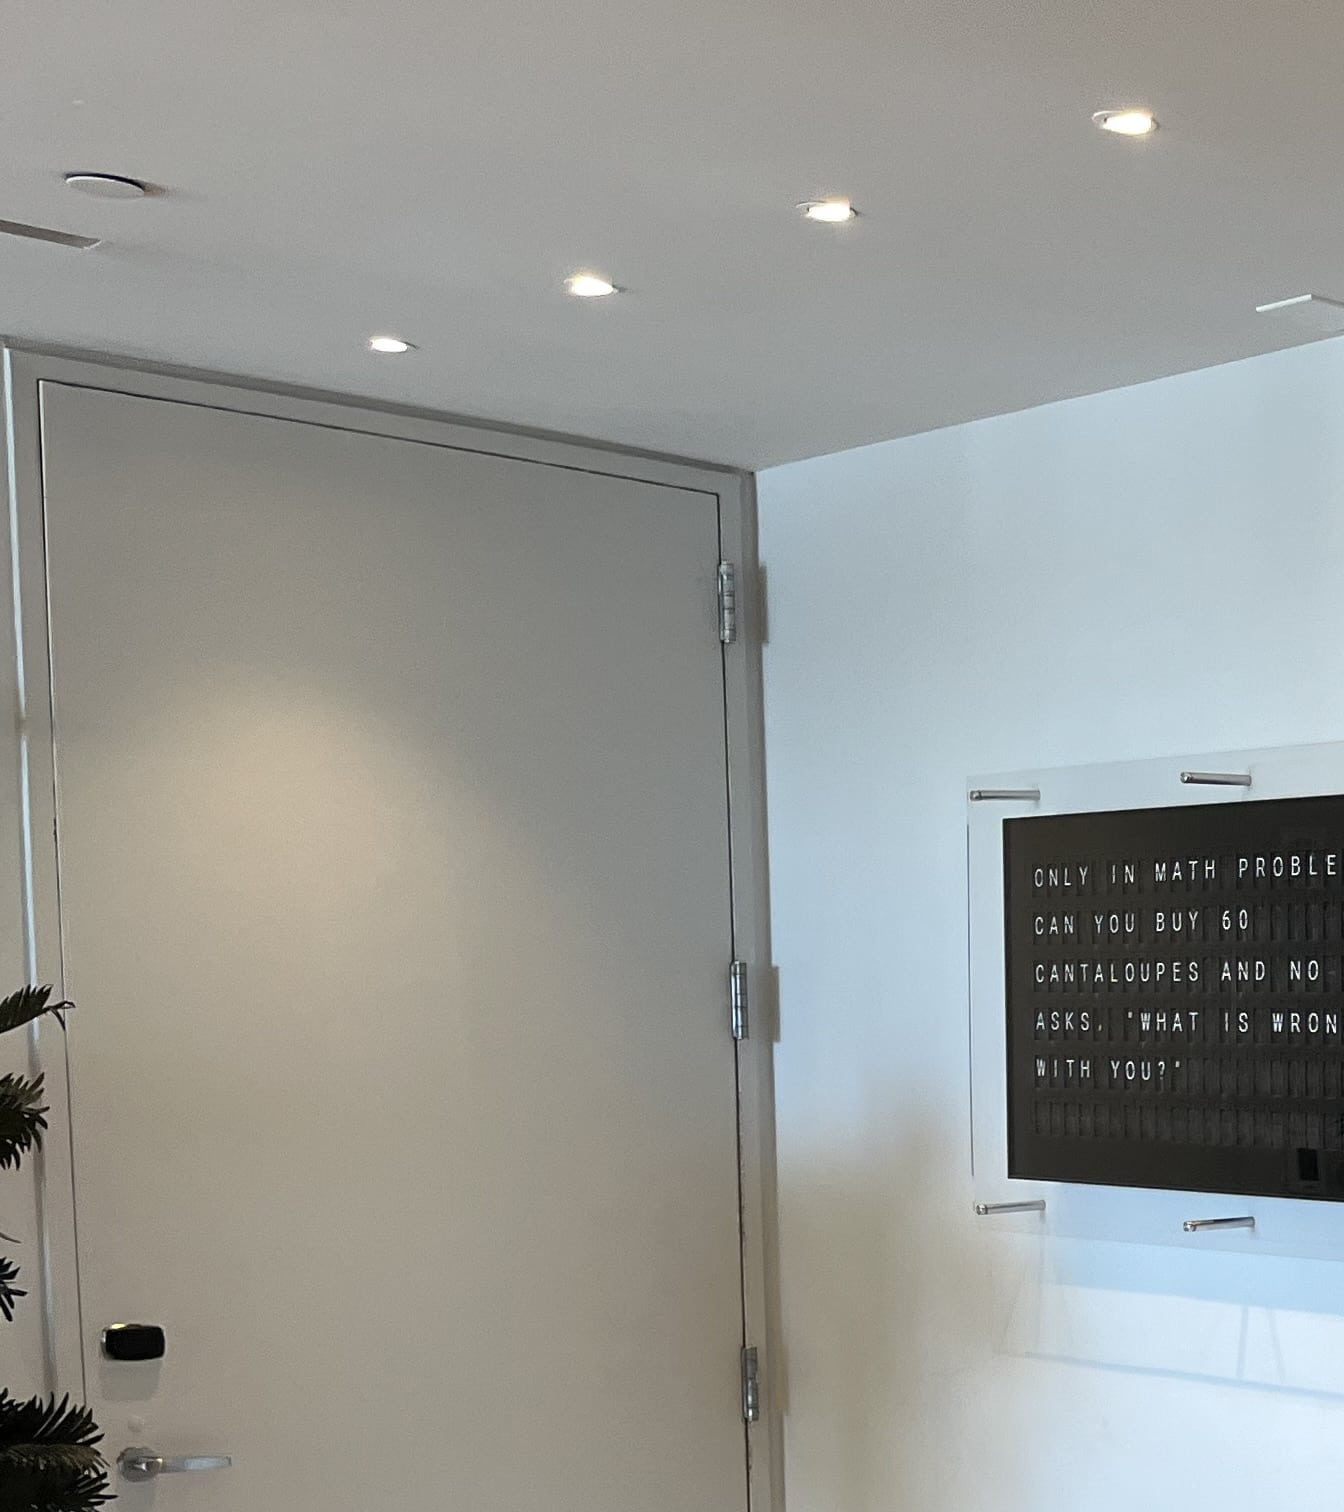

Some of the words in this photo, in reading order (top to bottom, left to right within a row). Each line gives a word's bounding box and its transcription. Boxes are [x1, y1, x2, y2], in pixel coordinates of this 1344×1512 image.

[1034, 866, 1088, 888] ONLY
[1111, 864, 1135, 884] IN
[1155, 860, 1216, 882] MATH
[1035, 915, 1074, 935] CAN
[1094, 913, 1135, 934] YOU
[1156, 911, 1199, 932] BUY
[1222, 909, 1248, 930] 60
[1035, 961, 1199, 983] CANTALOUPES
[1221, 961, 1265, 981] AND
[1290, 960, 1319, 981] NO
[1224, 1012, 1248, 1032] IS
[1036, 1058, 1091, 1079] WITH
